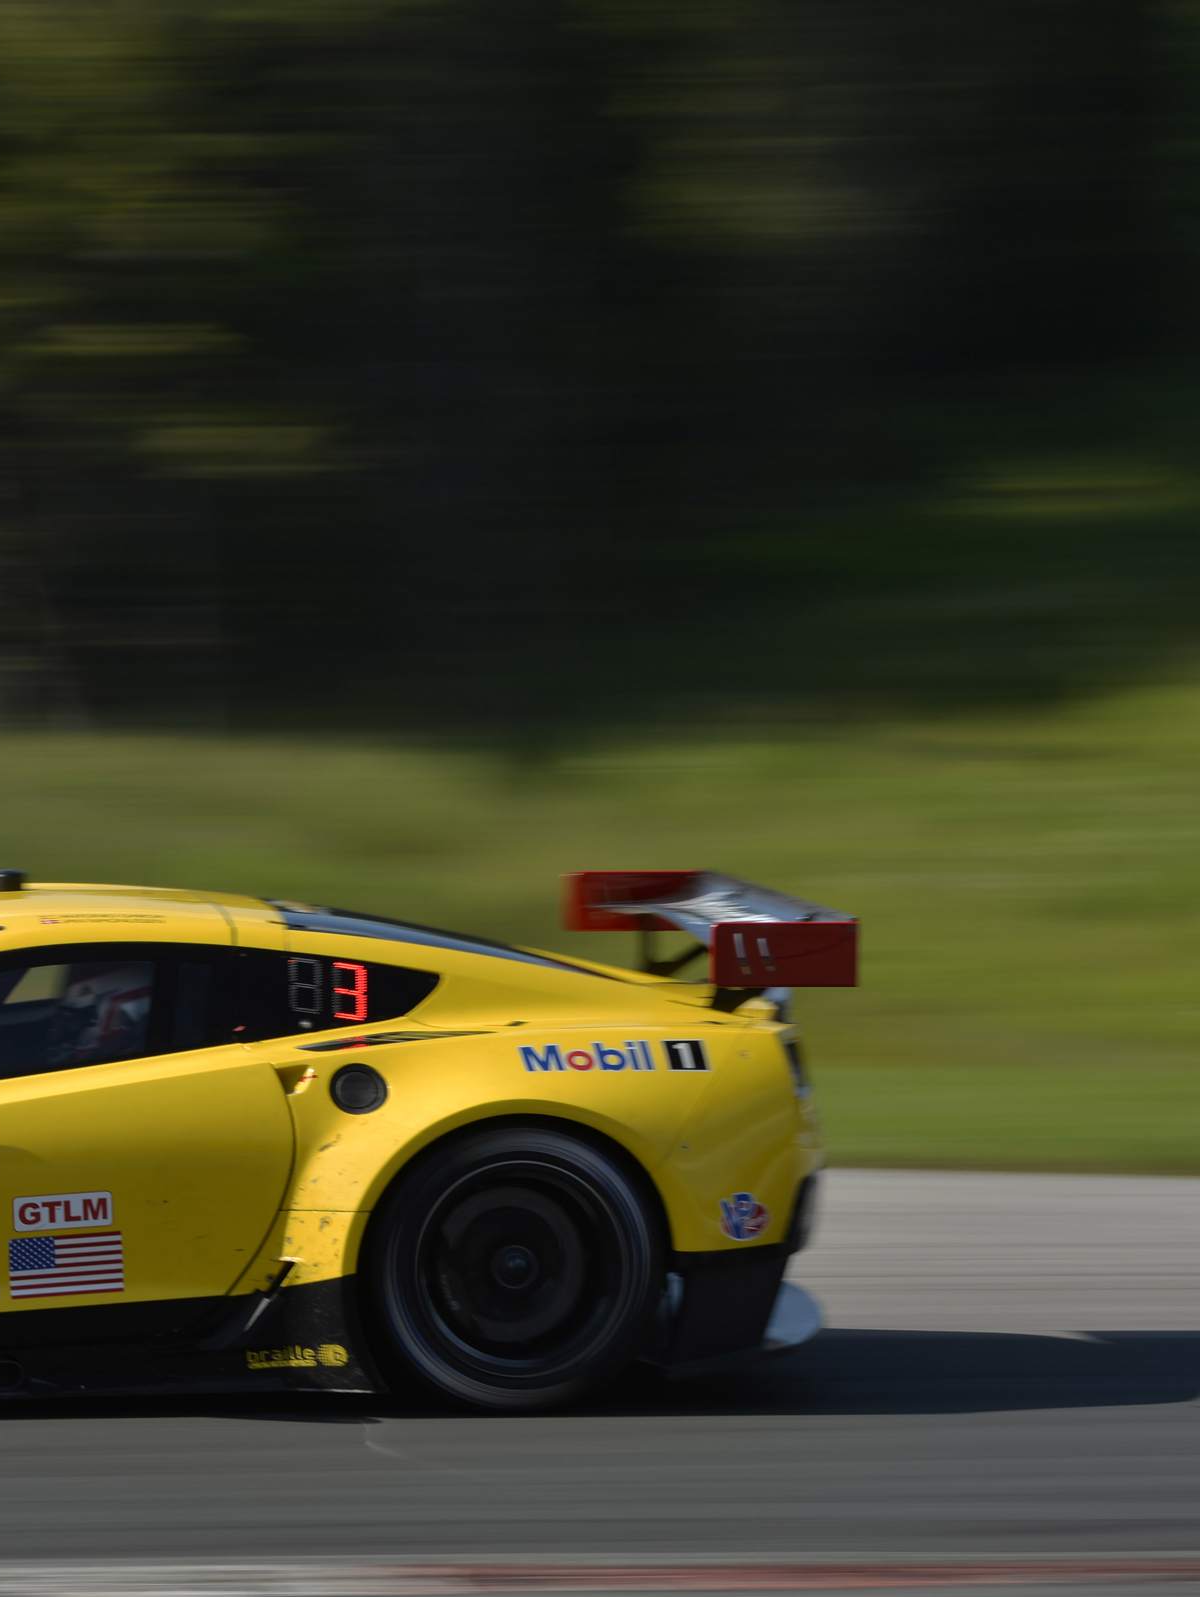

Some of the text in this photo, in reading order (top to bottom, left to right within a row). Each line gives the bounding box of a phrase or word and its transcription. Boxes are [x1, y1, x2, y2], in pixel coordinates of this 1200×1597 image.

[333, 961, 368, 1022] 3
[518, 1038, 699, 1073] Mobil 1
[18, 1197, 109, 1226] GTLM
